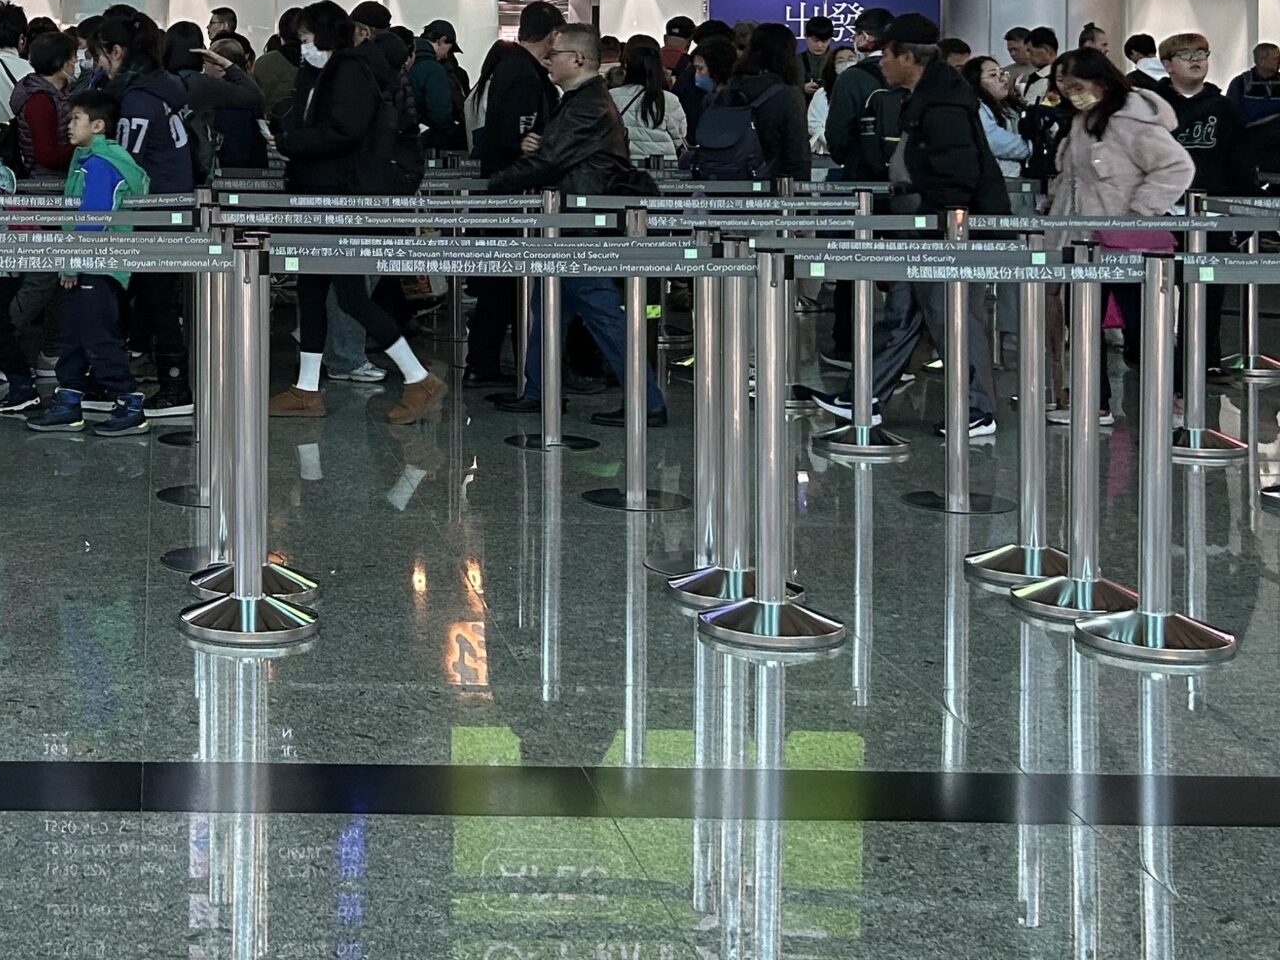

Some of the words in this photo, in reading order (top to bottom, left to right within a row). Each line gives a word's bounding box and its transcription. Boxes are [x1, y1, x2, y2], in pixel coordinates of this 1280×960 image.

[784, 1, 864, 41] 出發
[1040, 219, 1068, 228] Taoyuan
[1069, 219, 1110, 228] International
[1112, 219, 1136, 229] Airport
[1137, 218, 1177, 229] Corporation
[1178, 218, 1190, 227] Ltd
[1191, 218, 1218, 229] Security
[70, 256, 119, 269] 機場保全
[122, 258, 157, 268] Taoyuan
[158, 258, 211, 267] International
[530, 259, 581, 273] 機場保全
[583, 263, 618, 272] Taoyuan
[619, 263, 671, 272] International
[674, 264, 705, 273] Airport
[1070, 266, 1125, 279] 機場保全
